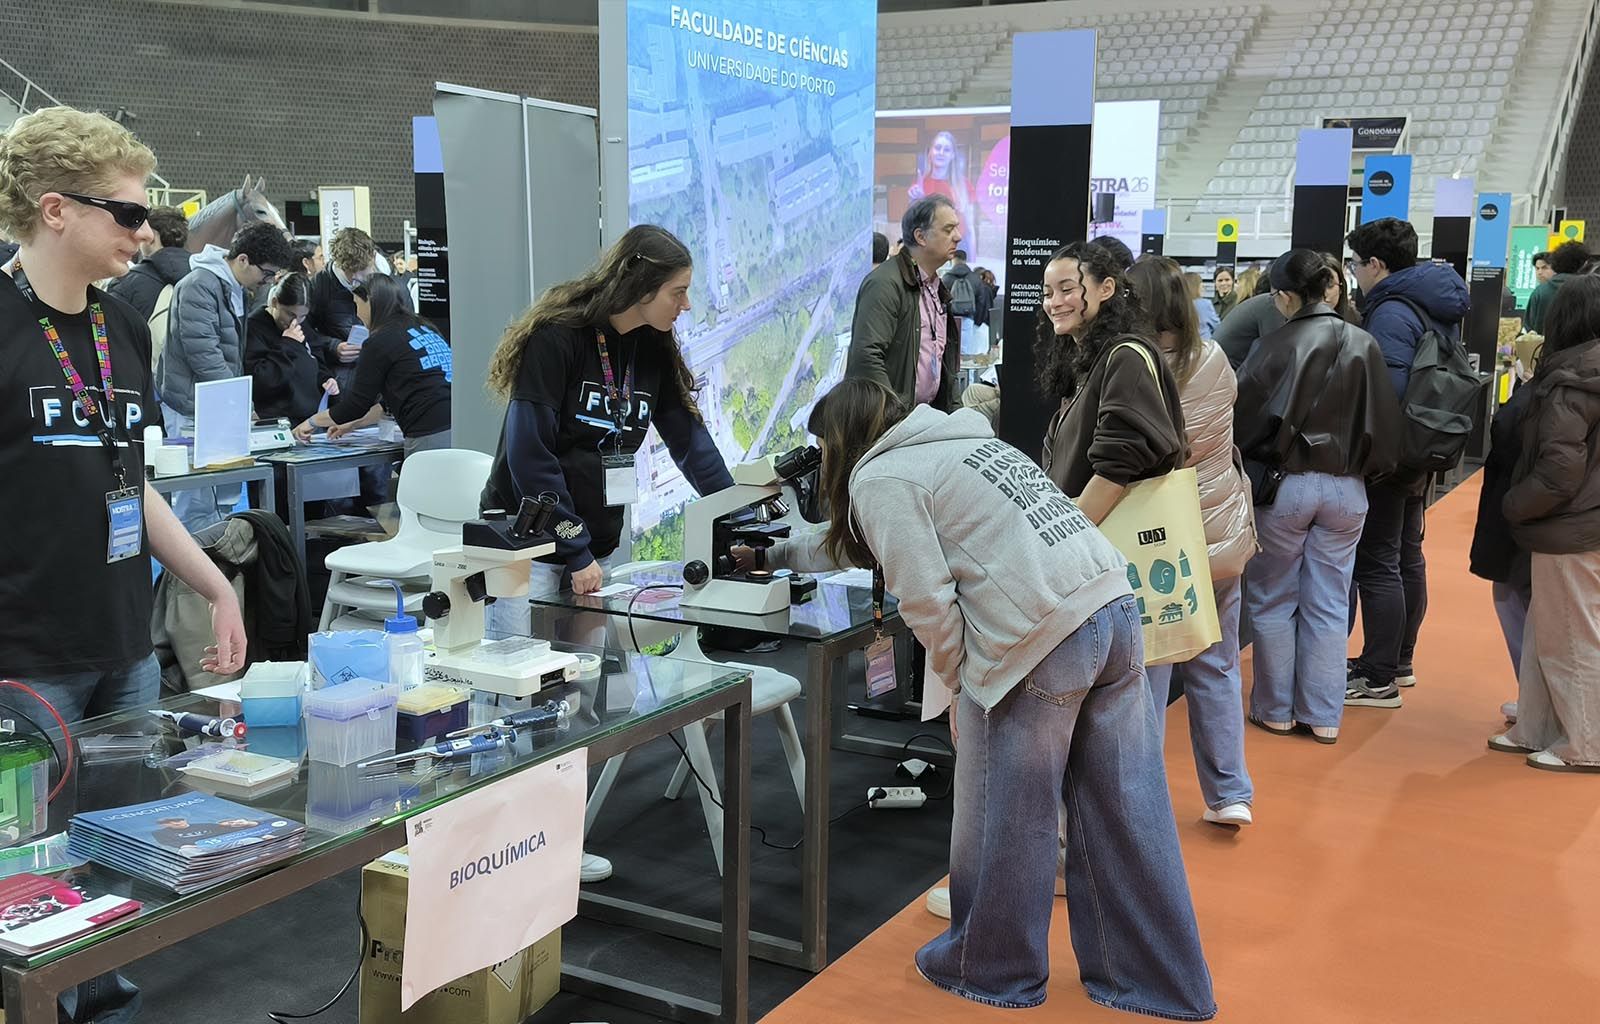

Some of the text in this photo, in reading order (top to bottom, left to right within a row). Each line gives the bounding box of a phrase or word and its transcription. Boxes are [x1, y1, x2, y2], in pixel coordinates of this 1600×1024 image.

[671, 5, 848, 69] FACULDADE DE CIÊNCIAS
[688, 50, 836, 97] UNIVERSIDADE DO PORTO
[1131, 176, 1149, 193] 26
[1012, 247, 1052, 256] moléculas
[1013, 238, 1060, 247] Bioquímica:
[1012, 257, 1041, 265] da vida
[42, 398, 142, 429] FCUP
[101, 798, 205, 821] LICENCIATURAS
[449, 830, 547, 890] BIOQUÍMICA
